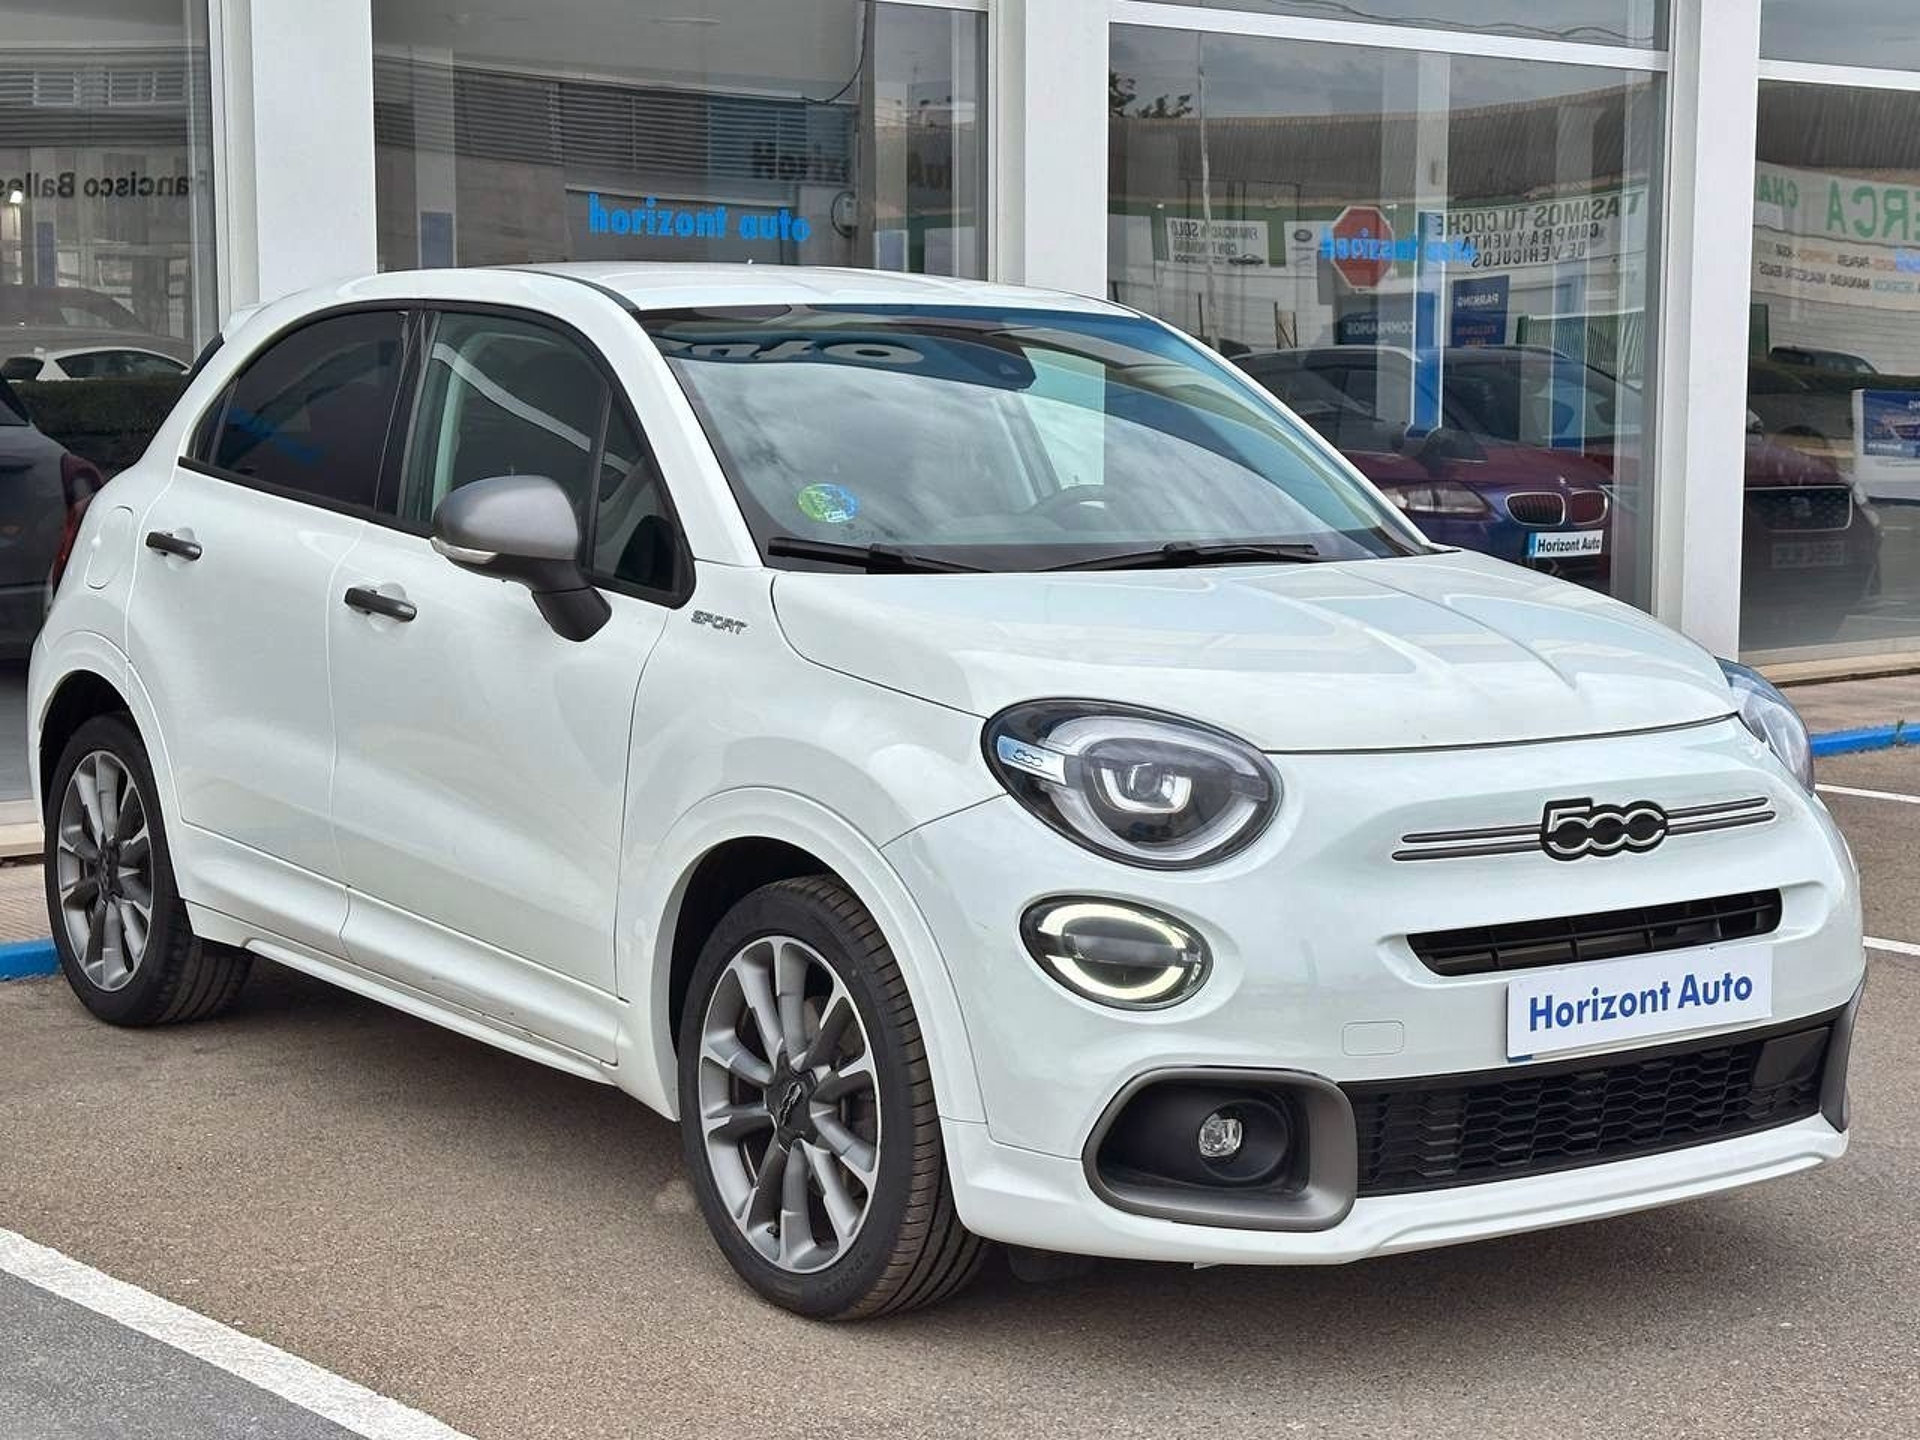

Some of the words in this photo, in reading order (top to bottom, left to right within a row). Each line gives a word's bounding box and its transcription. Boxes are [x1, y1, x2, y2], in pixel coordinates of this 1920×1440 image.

[588, 192, 728, 239] horizont
[739, 207, 811, 242] auto
[1537, 538, 1580, 553] Horizont
[1581, 537, 1601, 551] Auto
[691, 610, 748, 635] SPORT
[1541, 798, 1669, 862] 500
[1529, 979, 1672, 1032] Horizont
[1678, 971, 1754, 1010] Auto
